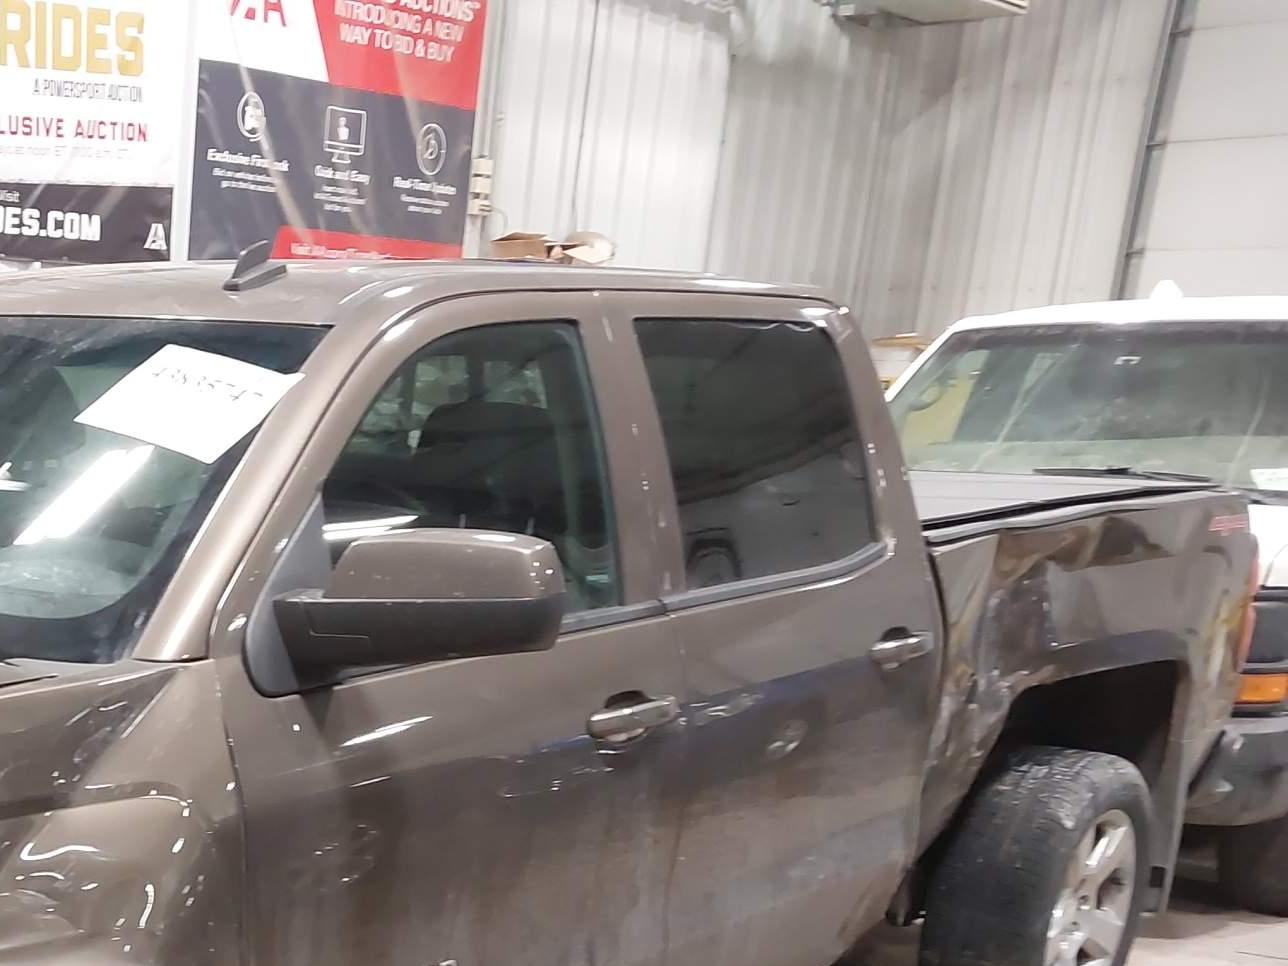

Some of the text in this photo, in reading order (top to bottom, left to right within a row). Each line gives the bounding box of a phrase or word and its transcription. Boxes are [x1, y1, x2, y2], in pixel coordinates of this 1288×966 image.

[339, 22, 455, 62] WAY TO BID & BUY
[422, 18, 433, 36] A
[434, 20, 465, 42] NEW
[73, 118, 148, 143] AUCTION
